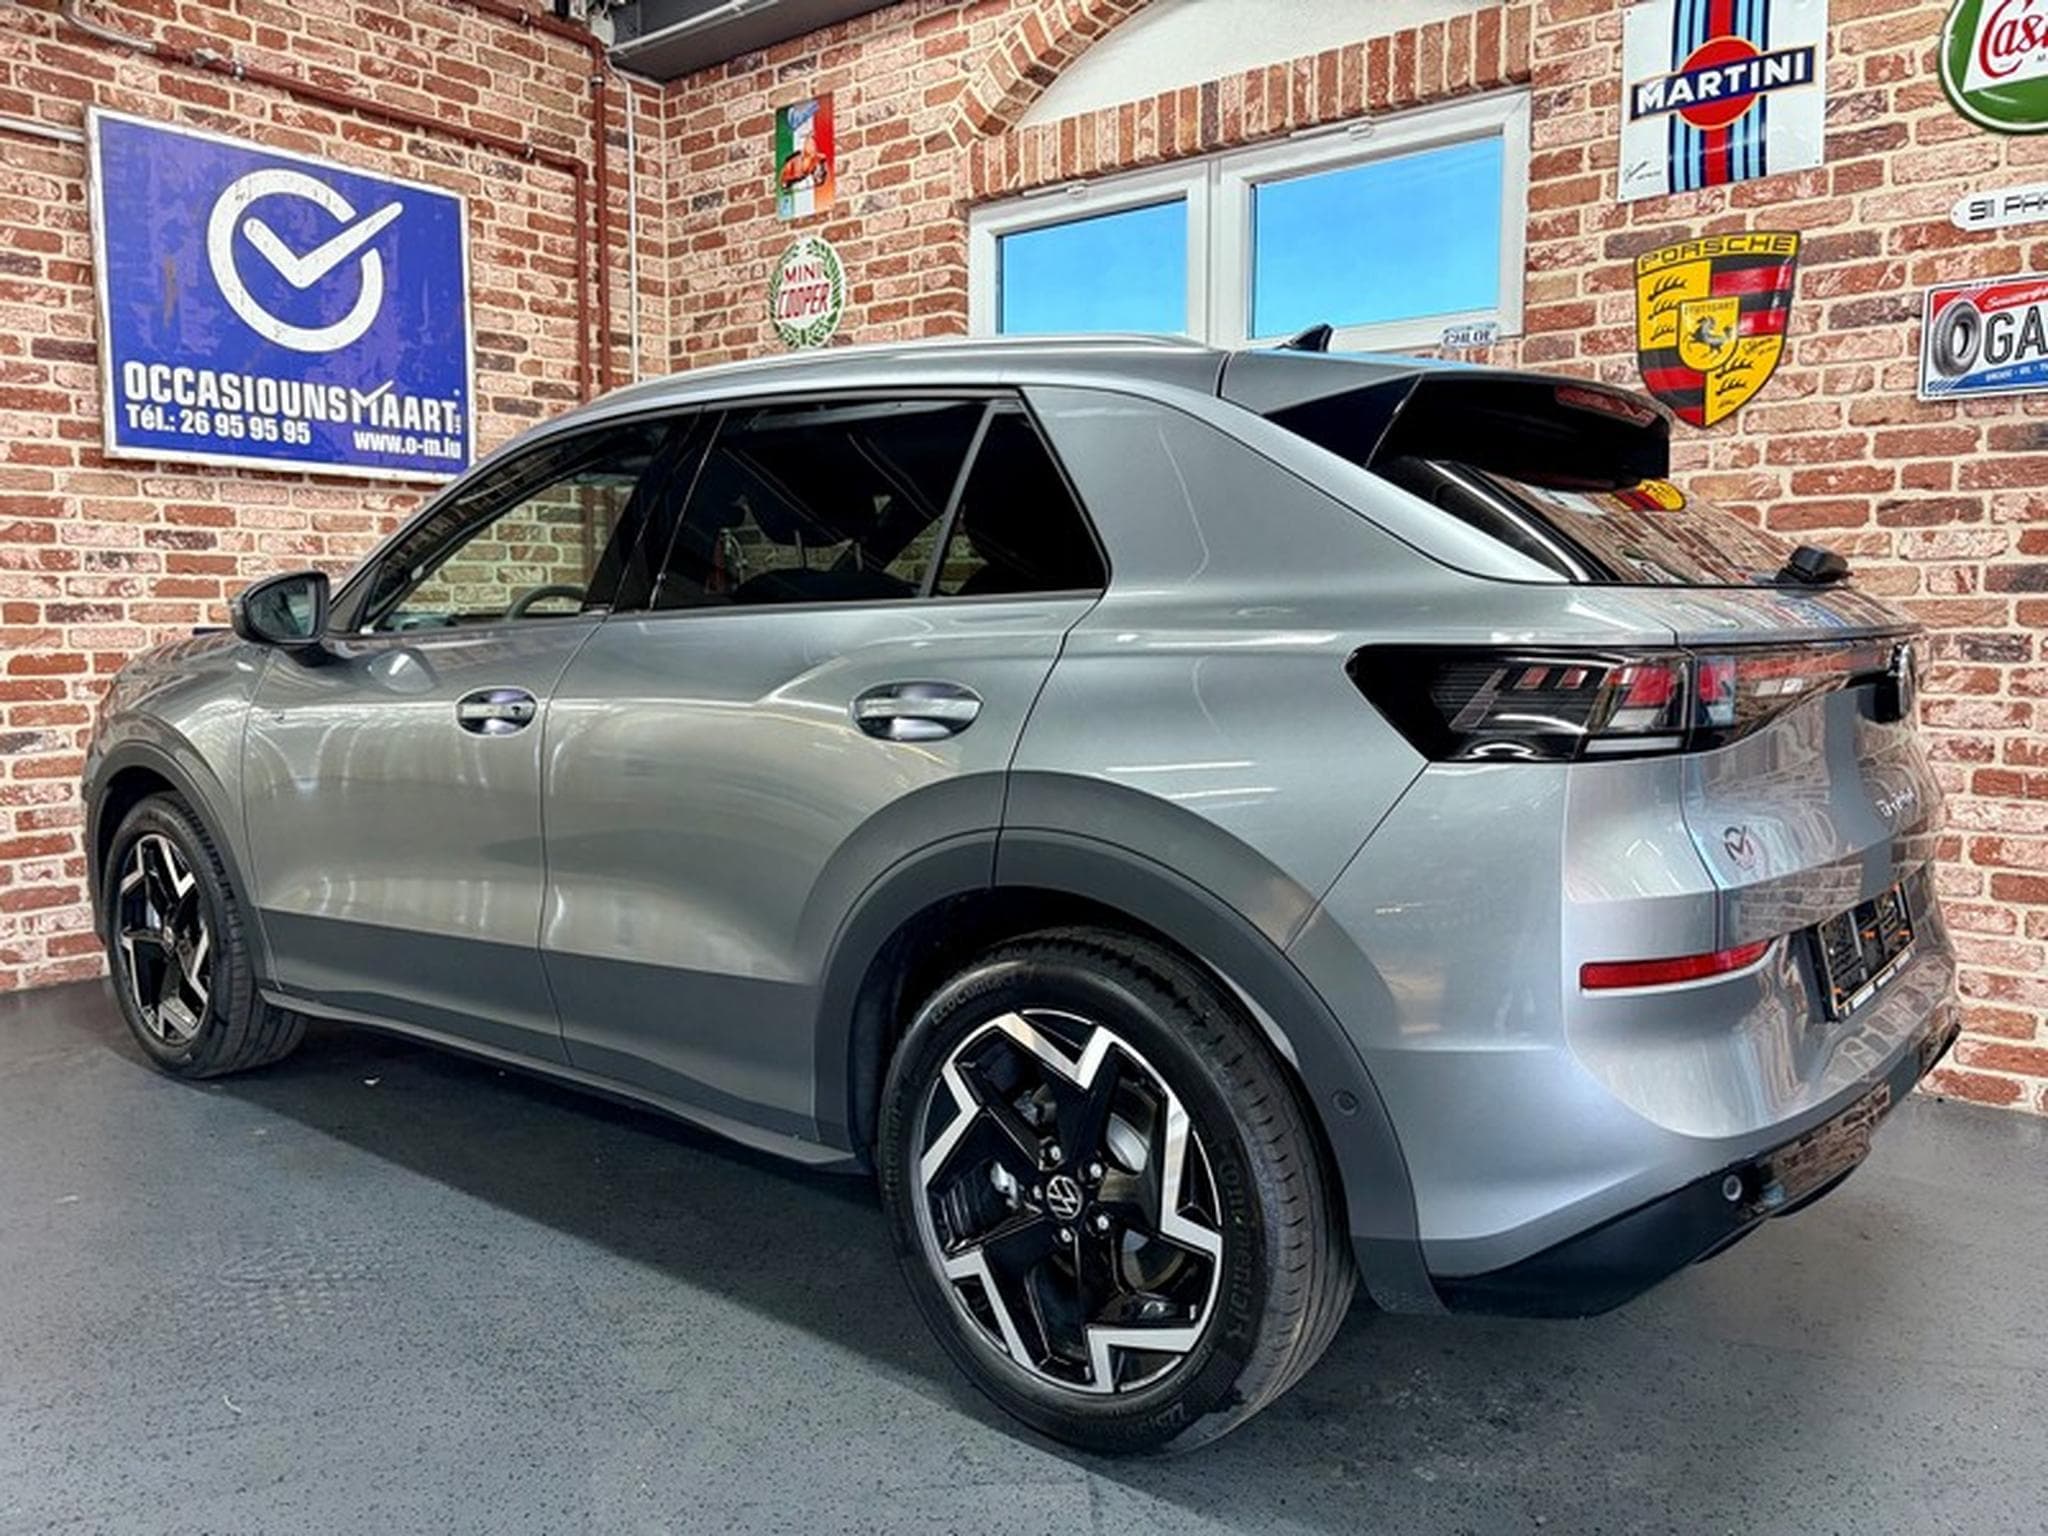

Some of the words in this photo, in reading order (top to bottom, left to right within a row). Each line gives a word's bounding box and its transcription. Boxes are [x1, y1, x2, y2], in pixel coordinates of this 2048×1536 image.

[1636, 51, 1806, 116] MARTINI
[785, 261, 822, 283] MINI
[1640, 236, 1793, 272] PORSCHE
[778, 283, 830, 320] COOPER
[123, 361, 457, 434] OCCASIOUNSMAART
[126, 402, 176, 432] Tél.:
[180, 409, 211, 437] 26
[213, 414, 244, 440] 95
[248, 417, 279, 442] 95
[282, 420, 311, 446] 95
[353, 430, 462, 460] www.o-m.lu
